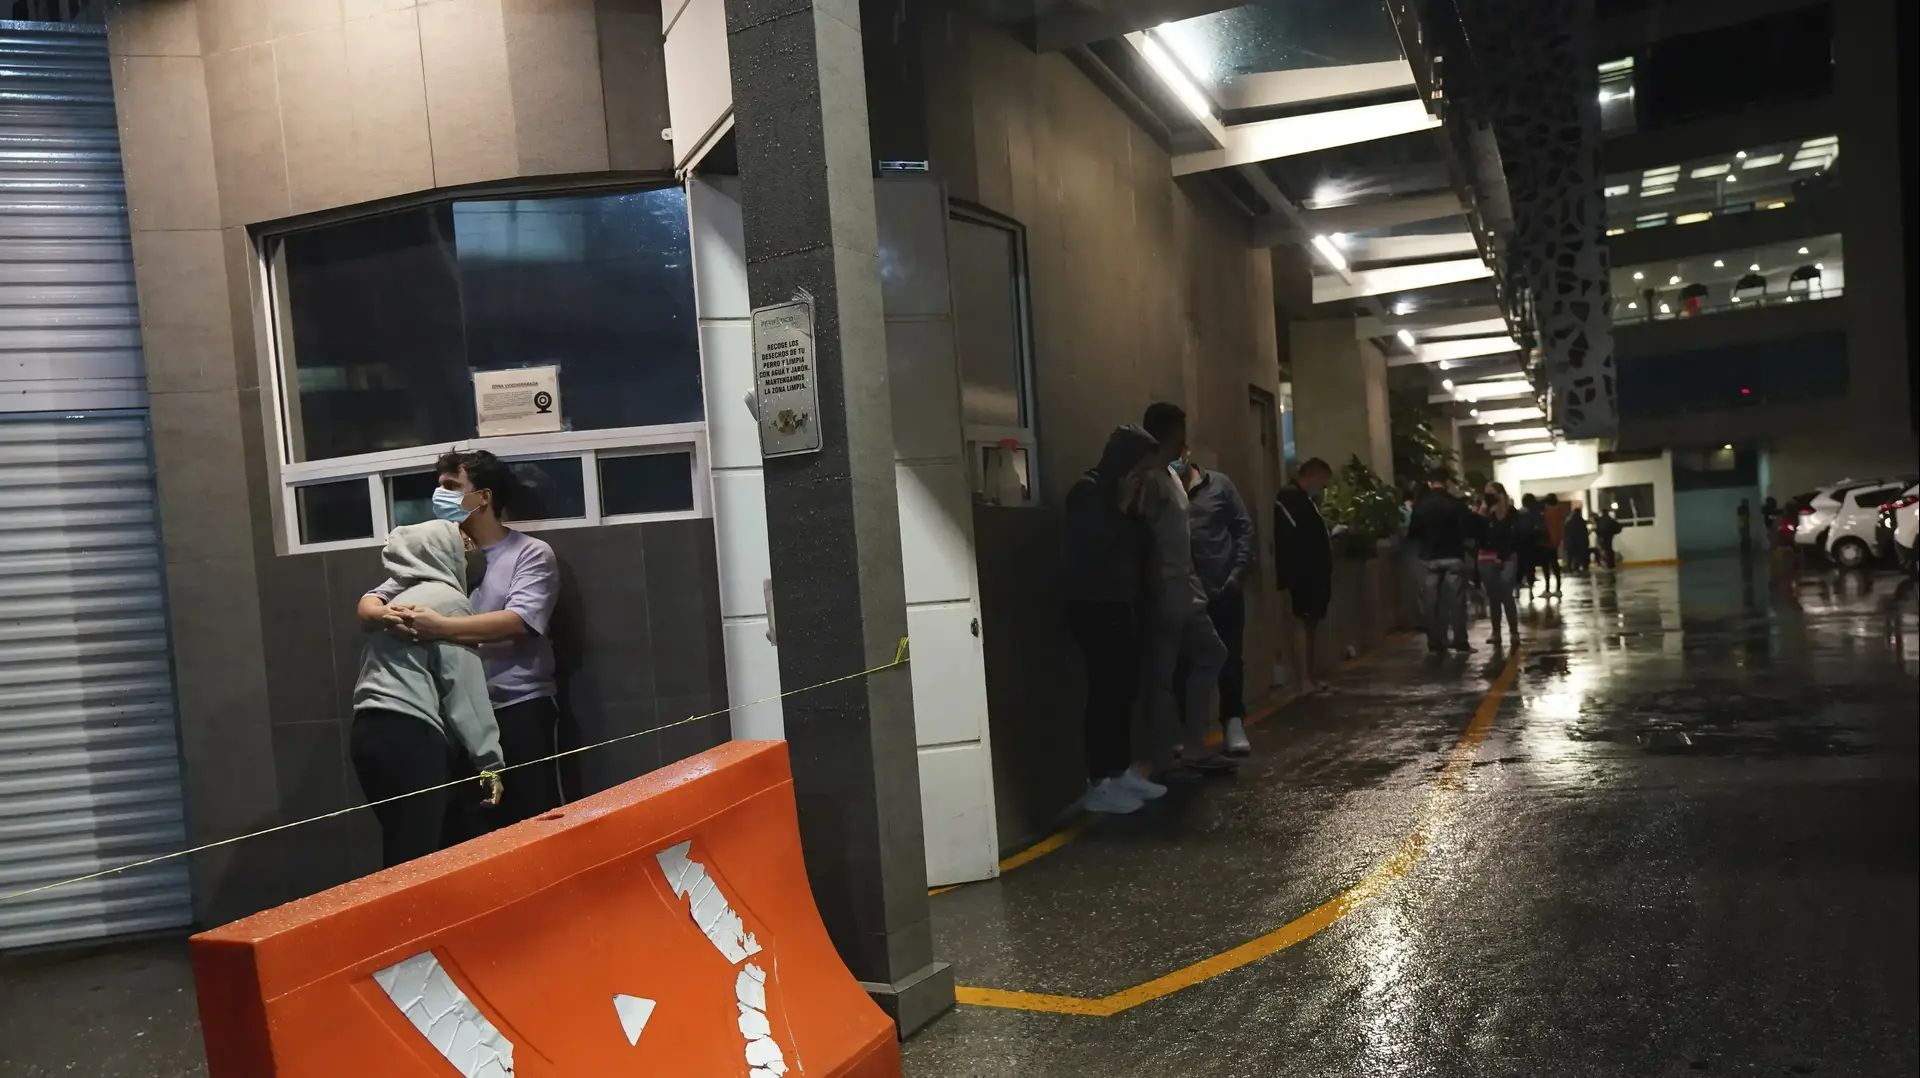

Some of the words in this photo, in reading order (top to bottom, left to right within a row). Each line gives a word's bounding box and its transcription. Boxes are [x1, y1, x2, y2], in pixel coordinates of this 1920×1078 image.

[767, 342, 787, 350] RECOGE
[762, 351, 789, 360] DESECHOS
[763, 360, 780, 369] PERRO
[781, 359, 786, 367] Y
[786, 357, 804, 365] LIMPIA
[759, 370, 770, 378] CON
[771, 368, 785, 377] AGUA
[765, 375, 805, 385] MANTENGAMOS
[765, 387, 770, 395] LA
[772, 385, 785, 394] ZONA
